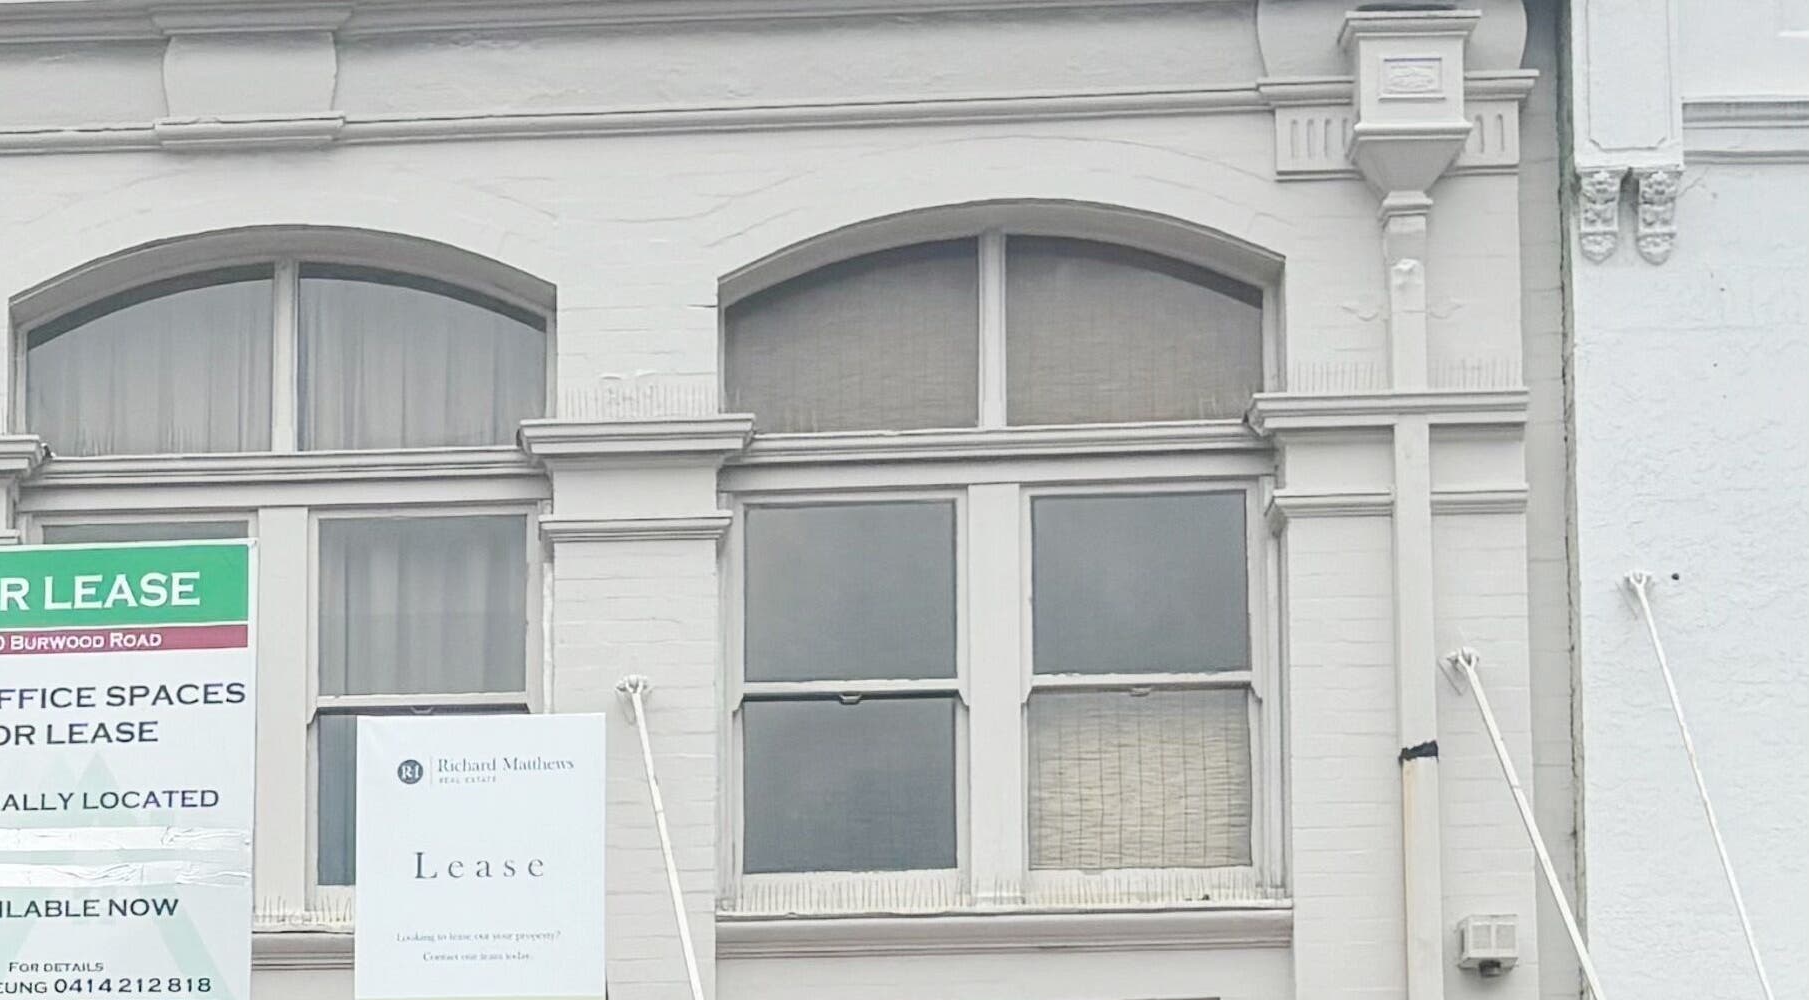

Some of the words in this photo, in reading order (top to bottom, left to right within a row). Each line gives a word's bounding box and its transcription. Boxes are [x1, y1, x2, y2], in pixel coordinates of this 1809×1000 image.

[44, 571, 201, 611] LEASE
[10, 633, 105, 651] BURWOOD
[109, 631, 163, 649] ROAD
[105, 682, 247, 707] SPACES
[46, 721, 159, 744] LEASE
[438, 757, 497, 773] Richard
[502, 755, 575, 771] Matthews
[82, 789, 220, 810] LOCATED
[414, 851, 544, 880] Lease
[108, 898, 180, 918] NOW
[9, 962, 39, 974] FOR
[43, 961, 105, 973] DETAILS
[53, 977, 113, 993] 0414
